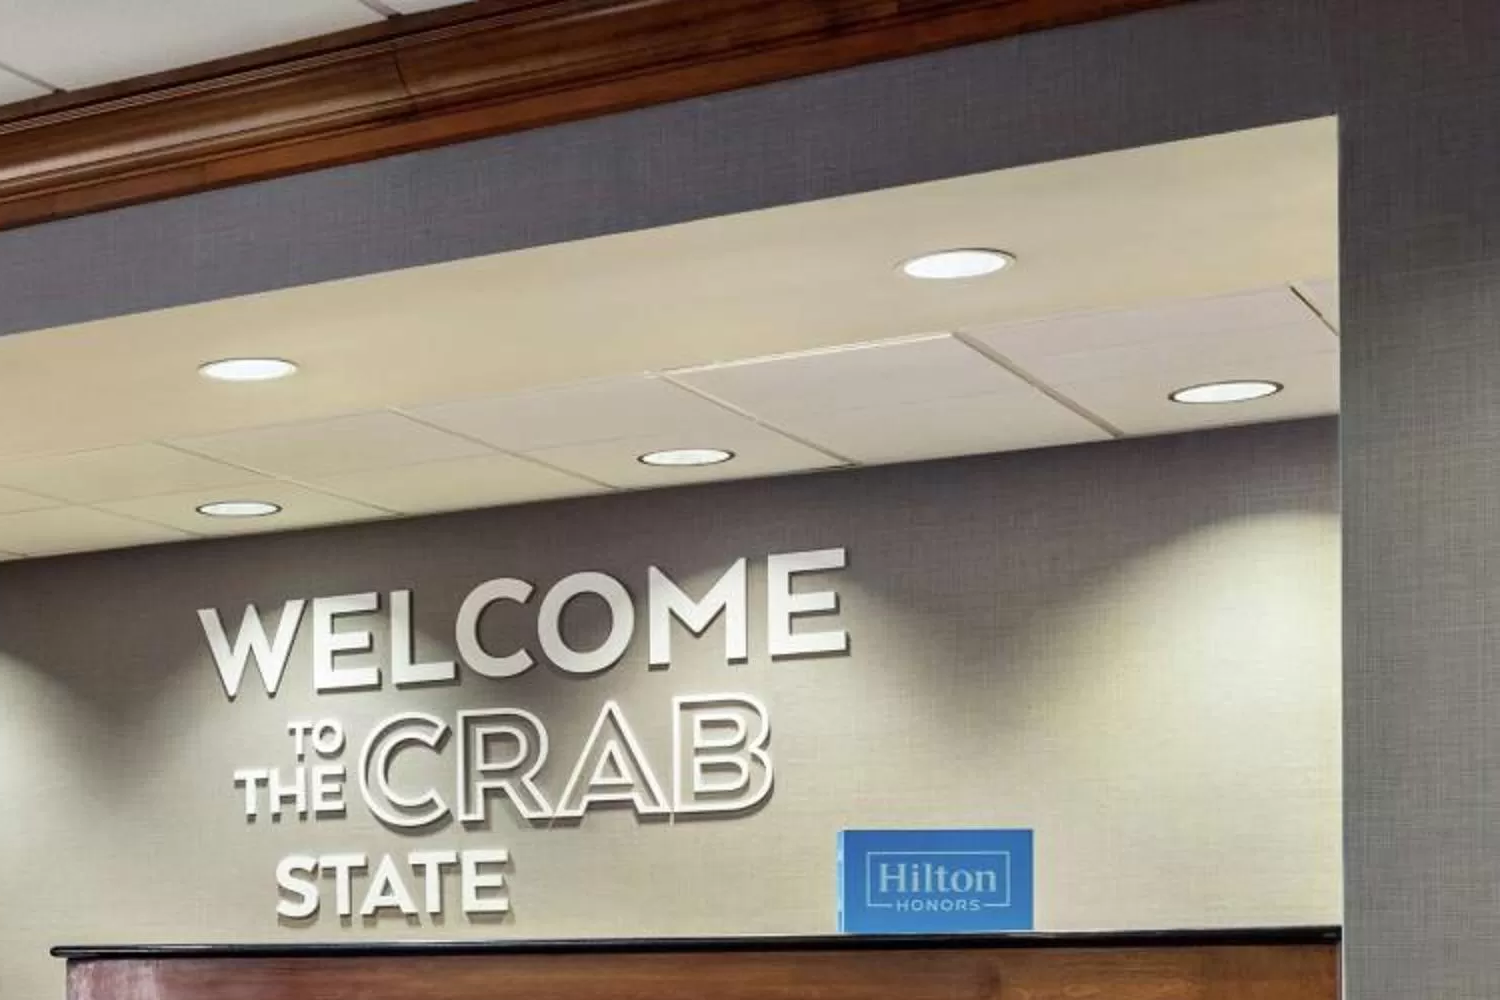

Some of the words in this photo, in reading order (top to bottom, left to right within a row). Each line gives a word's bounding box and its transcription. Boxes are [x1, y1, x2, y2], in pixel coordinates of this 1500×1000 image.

[197, 547, 849, 700] WELCOME
[288, 718, 344, 756] TO
[358, 692, 773, 828] CRAB
[234, 763, 346, 816] THE
[275, 849, 510, 918] STATE
[879, 862, 997, 893] Hilton
[896, 898, 981, 912] HONORS
